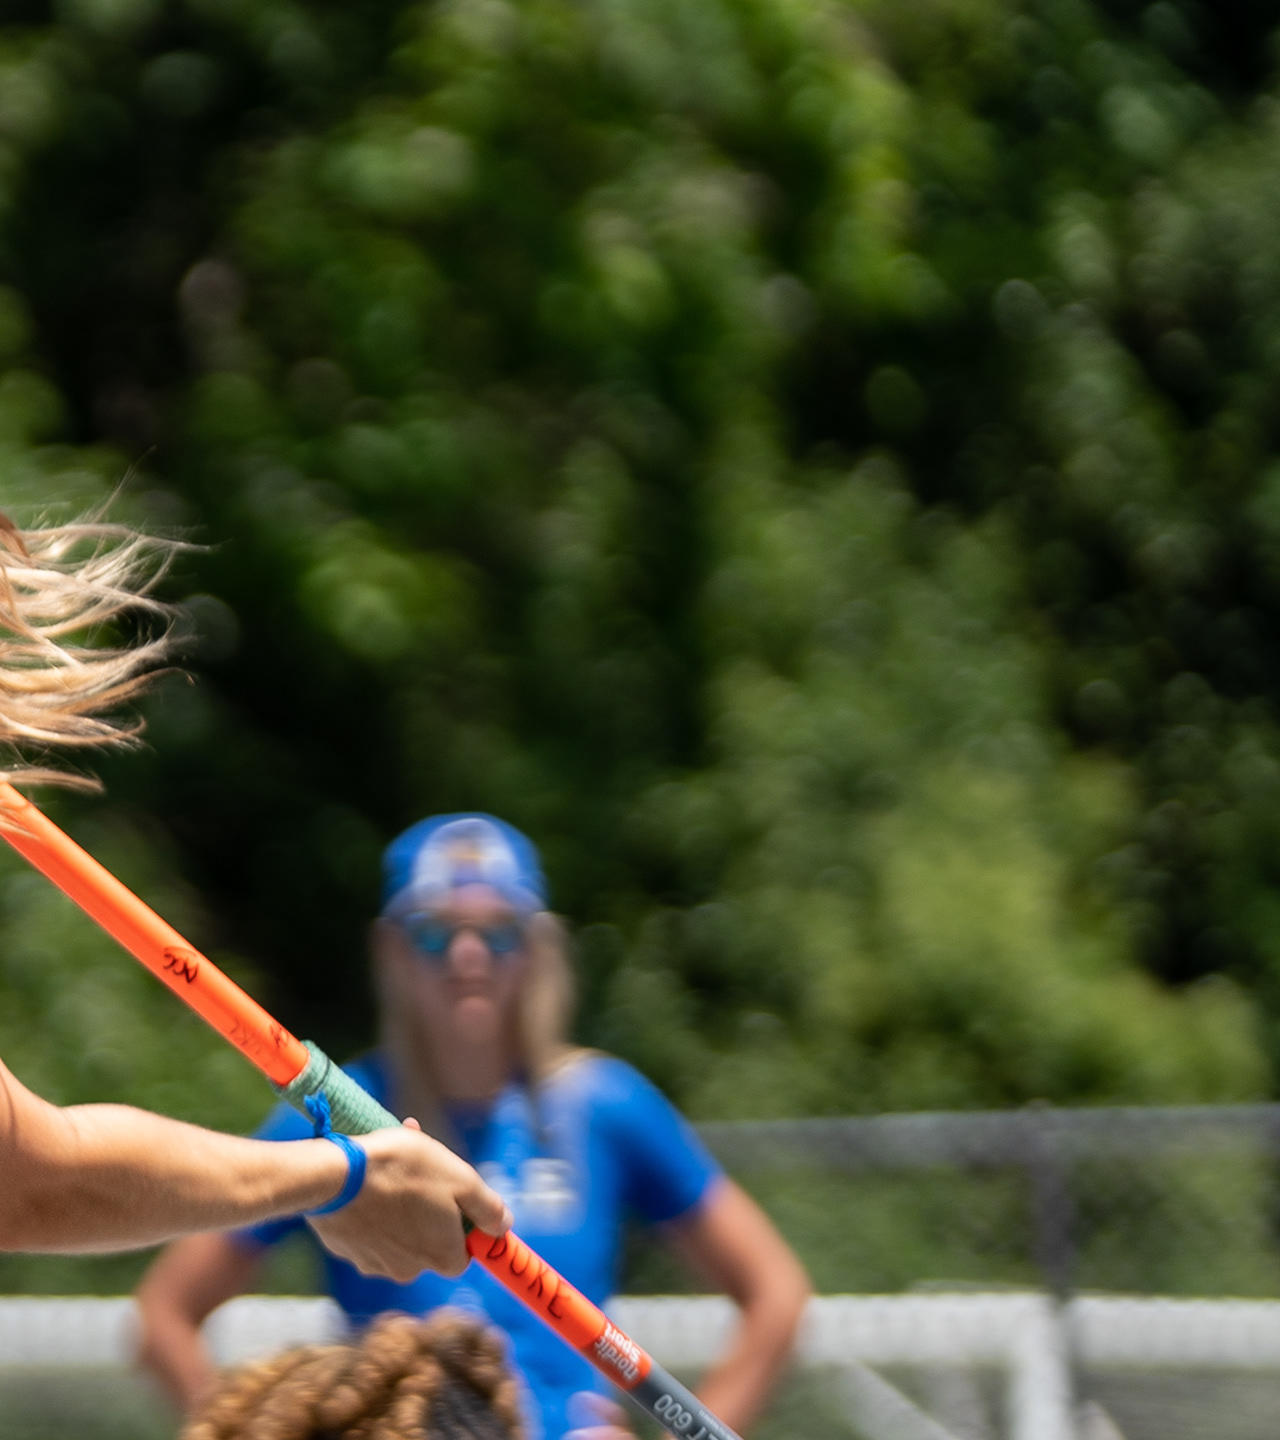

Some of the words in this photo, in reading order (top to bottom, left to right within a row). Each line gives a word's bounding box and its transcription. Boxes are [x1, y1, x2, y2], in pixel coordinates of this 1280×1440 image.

[486, 1236, 571, 1320] DUKE
[595, 1335, 639, 1380] nordic
[653, 1393, 694, 1431] 600
